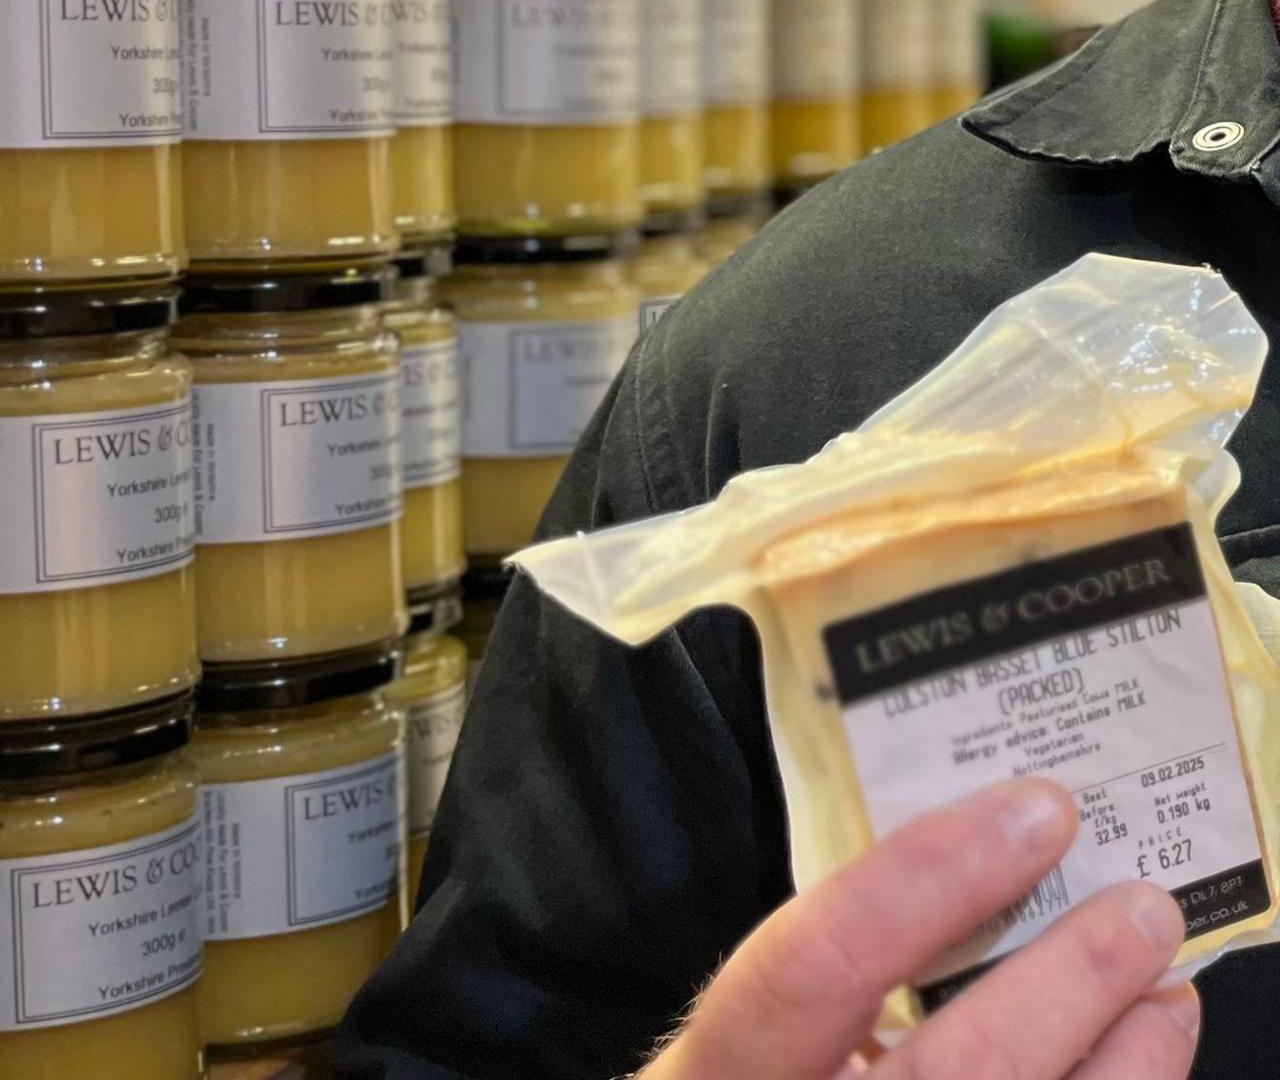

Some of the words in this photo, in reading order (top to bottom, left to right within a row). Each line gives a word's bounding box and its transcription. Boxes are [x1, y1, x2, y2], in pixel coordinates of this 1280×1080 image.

[274, 1, 359, 26] LEWIS
[281, 393, 367, 427] LEWIS
[54, 428, 151, 465] LEWIS
[106, 478, 168, 498] Yorkshire
[116, 544, 174, 564] Yorkshire
[855, 610, 974, 671] LEWIS
[980, 602, 1010, 633] &
[1017, 558, 1171, 620] COOPER
[975, 648, 1043, 689] BASSET
[1054, 629, 1099, 666] BLUE
[1107, 607, 1183, 649] STILTON
[998, 667, 1085, 716] (PACKED)
[1114, 677, 1141, 695] MILK
[952, 743, 998, 766] Allergy
[1056, 704, 1112, 732] Contains
[1116, 691, 1147, 713] MILK
[1024, 732, 1086, 757] Vegetarian
[1012, 741, 1102, 778] Nottinghamshire
[1141, 755, 1206, 788] 09.02.2025
[303, 780, 384, 821] LEWIS
[1083, 787, 1107, 805] Best
[1154, 793, 1172, 807] Net
[1176, 781, 1208, 801] weight
[1156, 801, 1190, 824] 0.190
[1195, 797, 1212, 813] kg
[1094, 822, 1129, 846] 32.99
[1136, 854, 1151, 879] £
[1158, 838, 1193, 870] 6.27
[33, 865, 138, 908] LEWIS
[146, 856, 166, 884] &
[88, 909, 158, 937] Yorkshire
[142, 934, 176, 957] 300g
[99, 974, 164, 1001] Yorkshire
